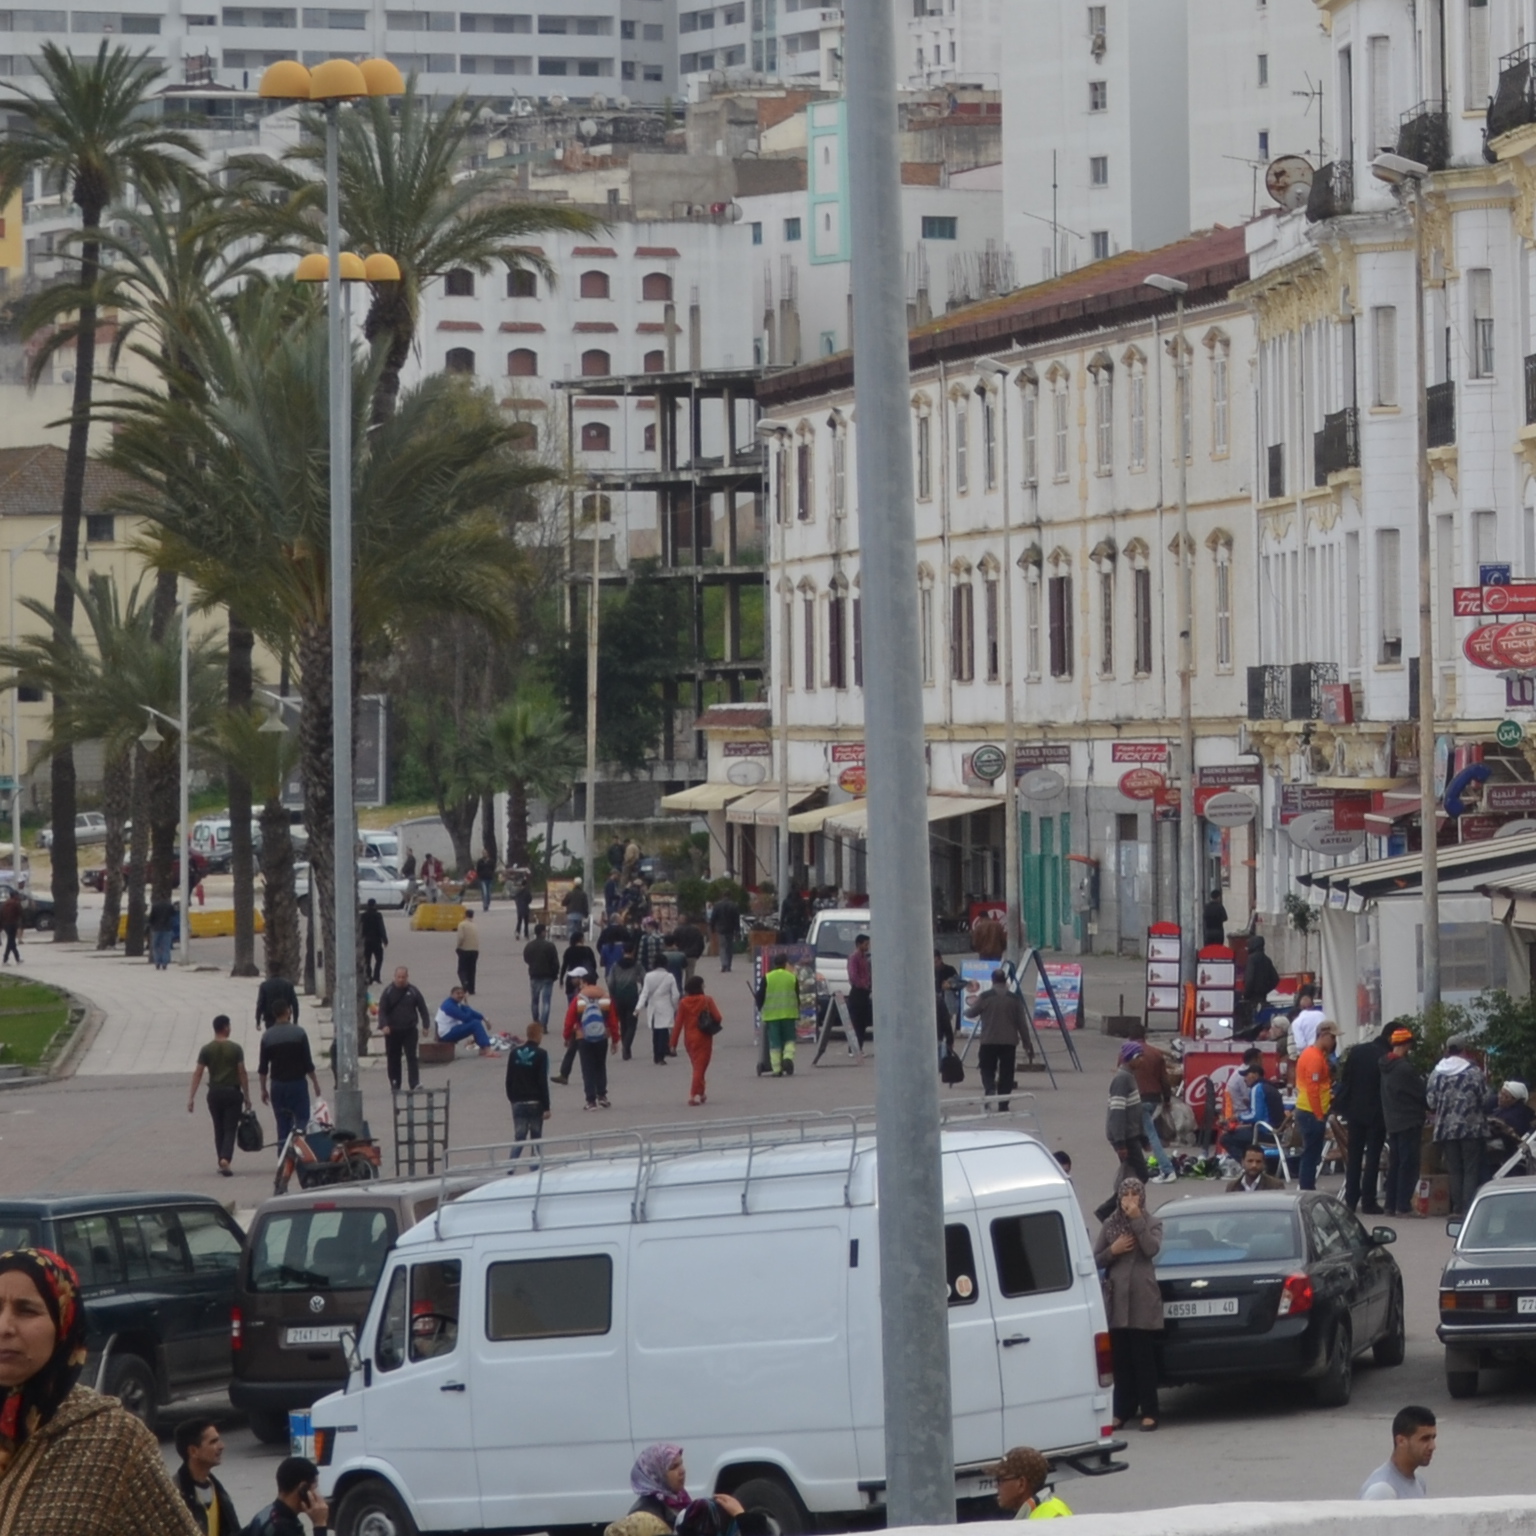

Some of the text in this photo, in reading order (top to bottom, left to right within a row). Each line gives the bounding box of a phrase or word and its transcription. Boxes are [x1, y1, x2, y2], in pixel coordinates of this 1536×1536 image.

[834, 752, 866, 761] TICKE
[1042, 748, 1069, 757] TOURS
[1114, 751, 1167, 761] TICKETS
[1320, 837, 1353, 845] BATEAU
[1167, 1303, 1197, 1316] 48598
[1222, 1300, 1234, 1312] 40
